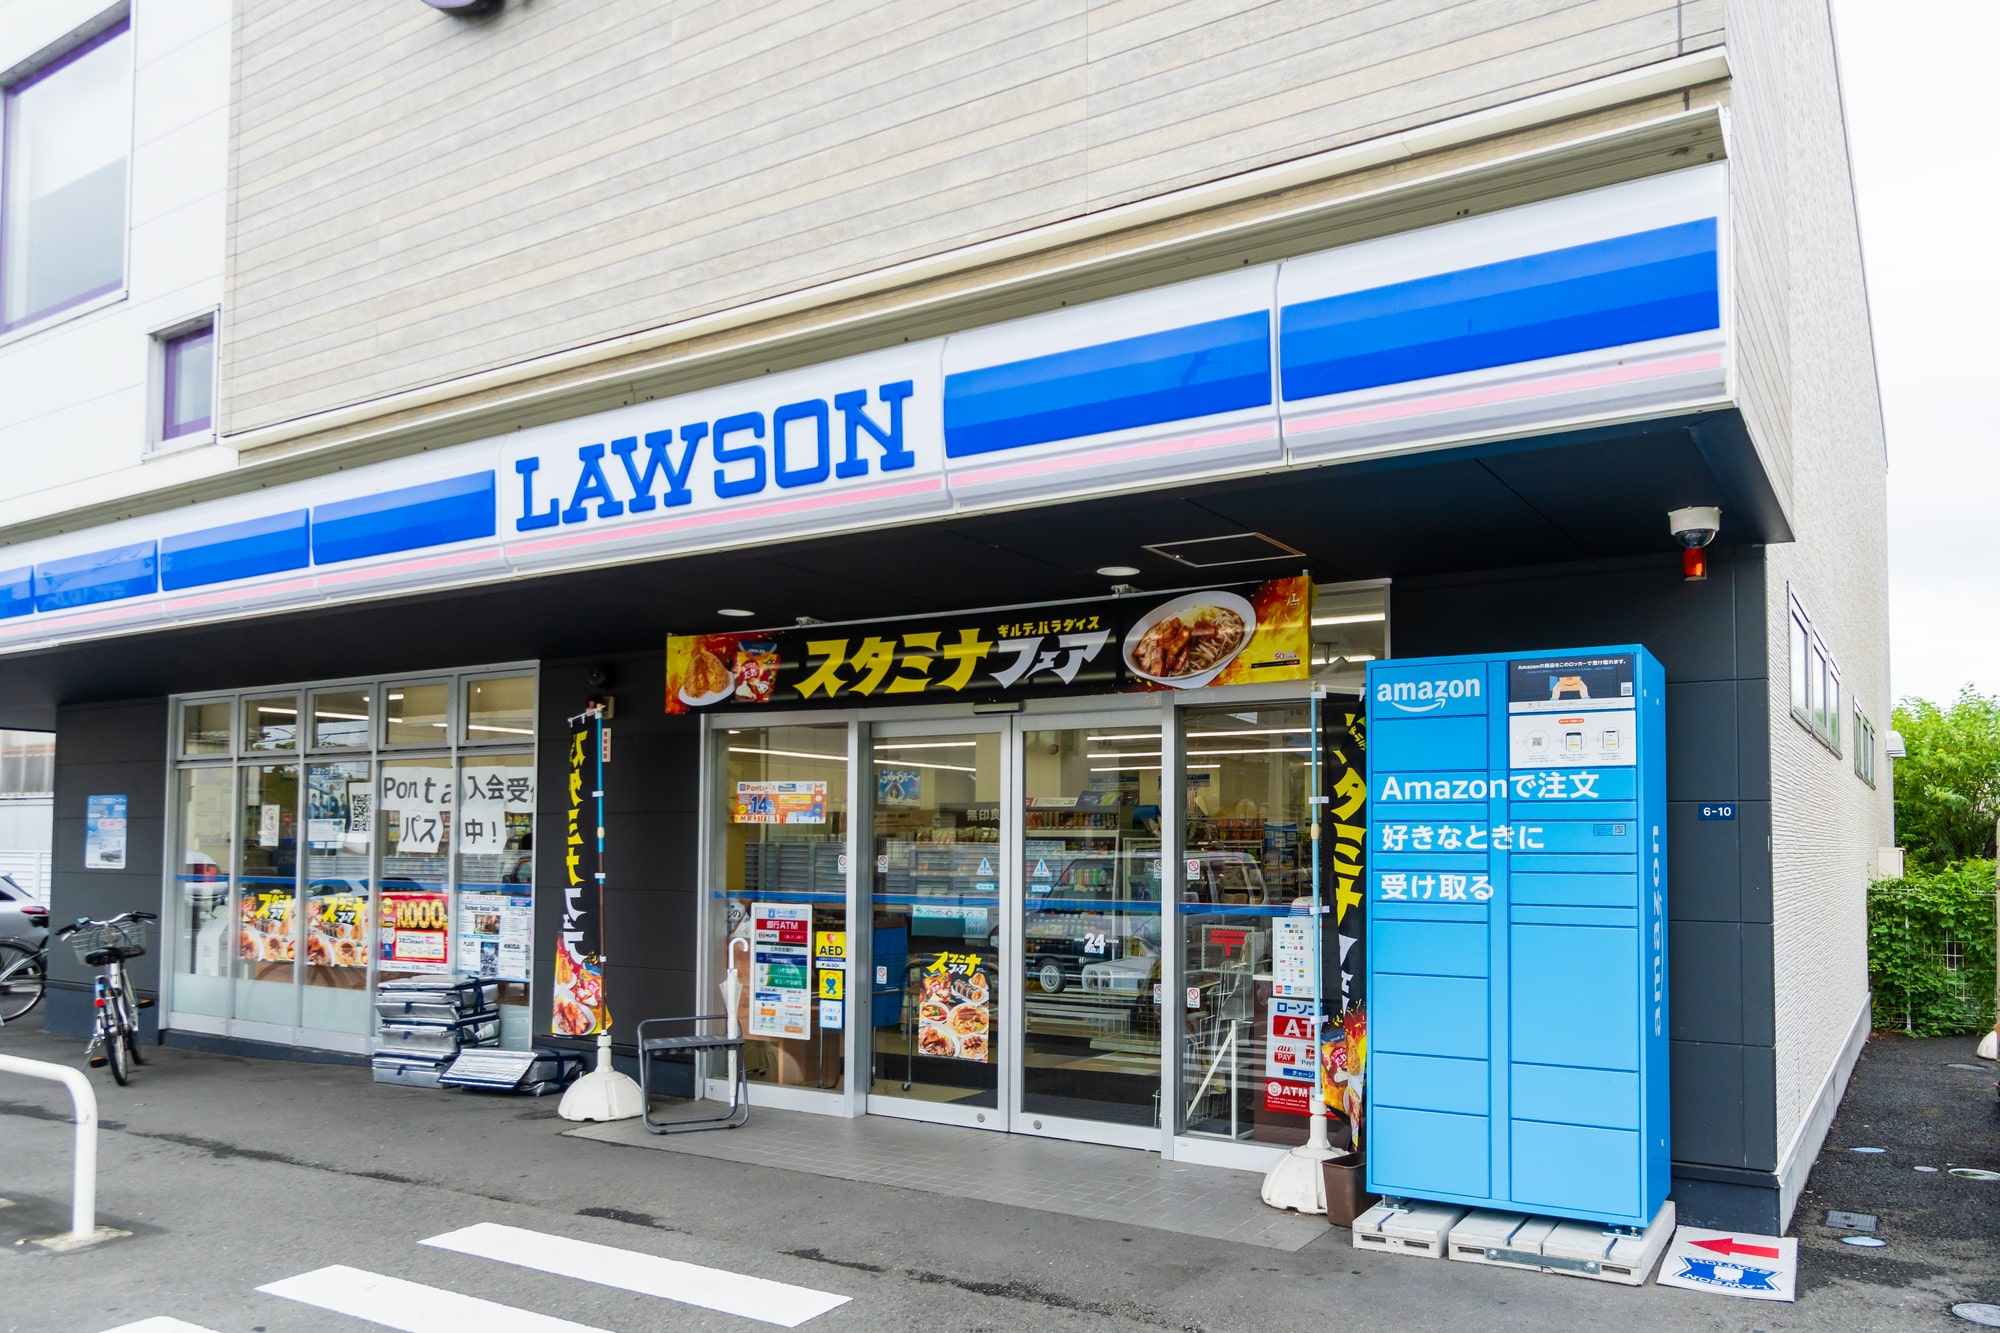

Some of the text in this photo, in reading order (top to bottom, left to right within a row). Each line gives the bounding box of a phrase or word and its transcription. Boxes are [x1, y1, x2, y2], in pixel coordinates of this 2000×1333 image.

[515, 379, 915, 532] LAWSON
[997, 615, 1100, 637] ギルティパラダイス
[1376, 678, 1481, 703] amazon
[467, 774, 535, 803] 入会受
[1380, 771, 1600, 800] Amazonで注文
[1703, 807, 1732, 817] 6-10
[402, 815, 437, 844] パス
[1382, 825, 1545, 851] 好きなときに
[1381, 874, 1494, 901] 受け取る
[766, 920, 799, 931] 銀行ATM
[1652, 825, 1663, 1037] amazon
[819, 945, 843, 957] AED
[1084, 932, 1106, 955] 24
[926, 951, 983, 977] スタミナ
[1283, 1018, 1315, 1039] AT
[1277, 1054, 1293, 1062] PAY
[1282, 1086, 1308, 1098] ATM
[1683, 1273, 1771, 1290] LAWSON
